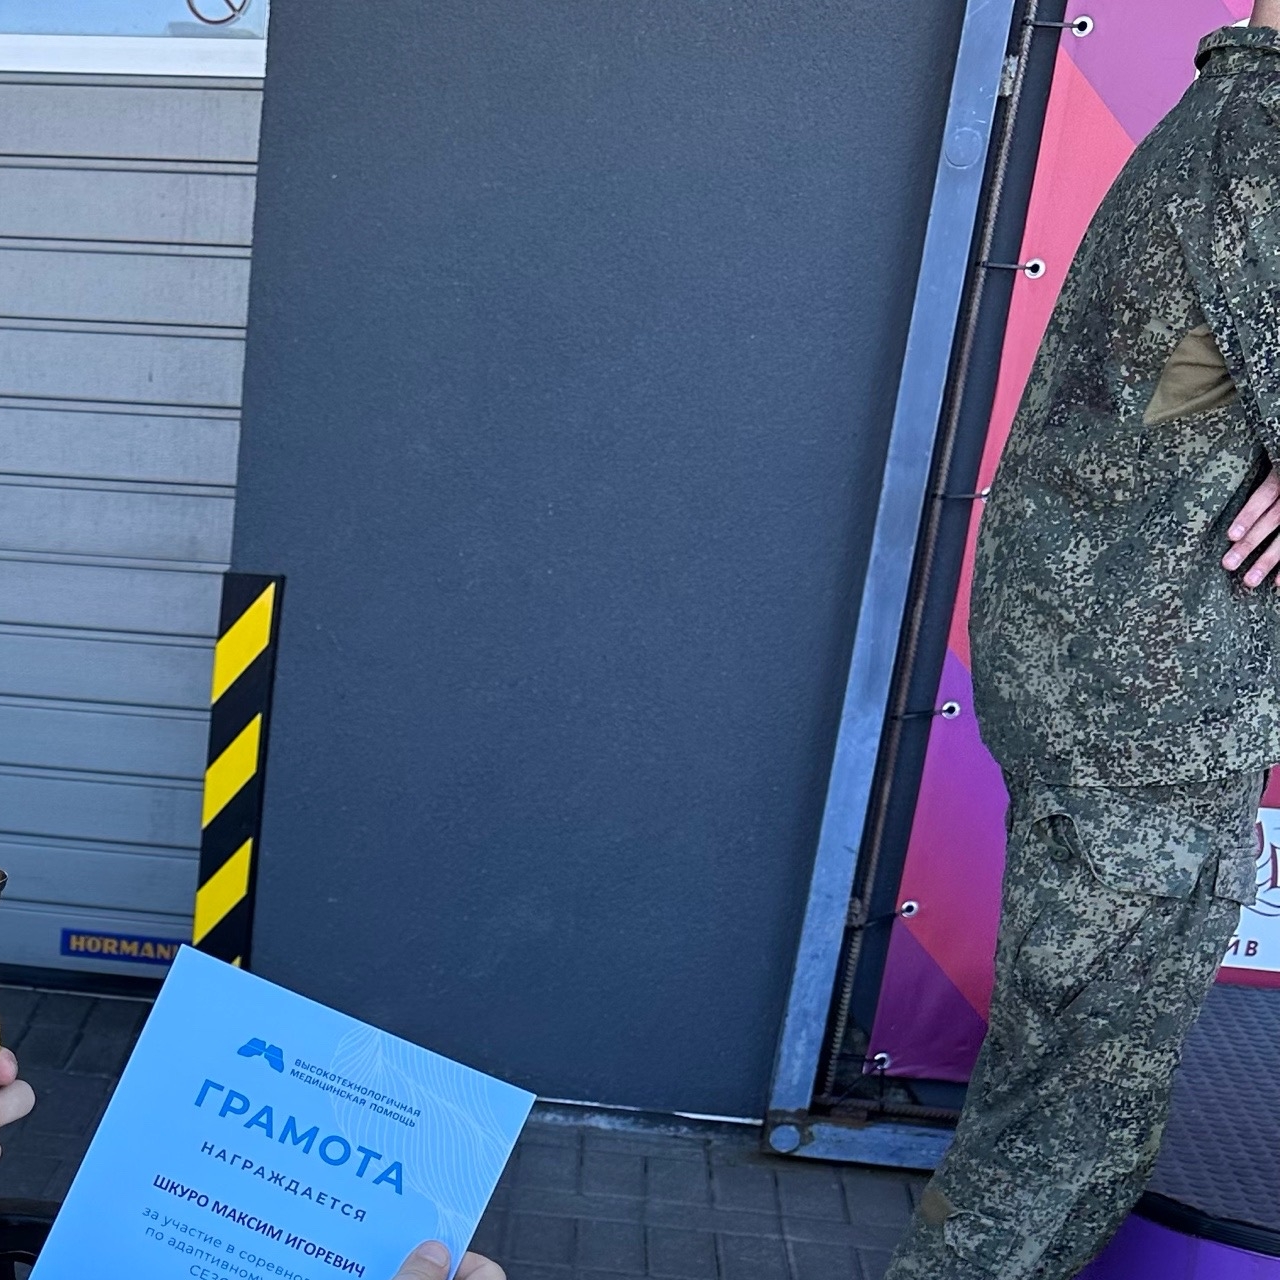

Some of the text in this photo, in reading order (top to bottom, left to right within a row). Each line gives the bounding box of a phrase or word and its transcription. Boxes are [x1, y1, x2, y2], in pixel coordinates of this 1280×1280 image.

[289, 1068, 416, 1128] МЕДИЦИНСКАЯ ПОМОЩЬ
[294, 1058, 421, 1118] ВЫСОКОТЕХНОЛОГИЧНАЯ
[194, 1078, 404, 1196] ГРАМОТА
[200, 1141, 367, 1223] НАГРАЖДАЕТСЯ
[142, 1207, 160, 1221] за
[161, 1214, 222, 1248] участие
[225, 1243, 236, 1254] в
[145, 1226, 164, 1241] по
[153, 1174, 366, 1279] ШКУРО МАКСИМ ИГОРЕВИЧ
